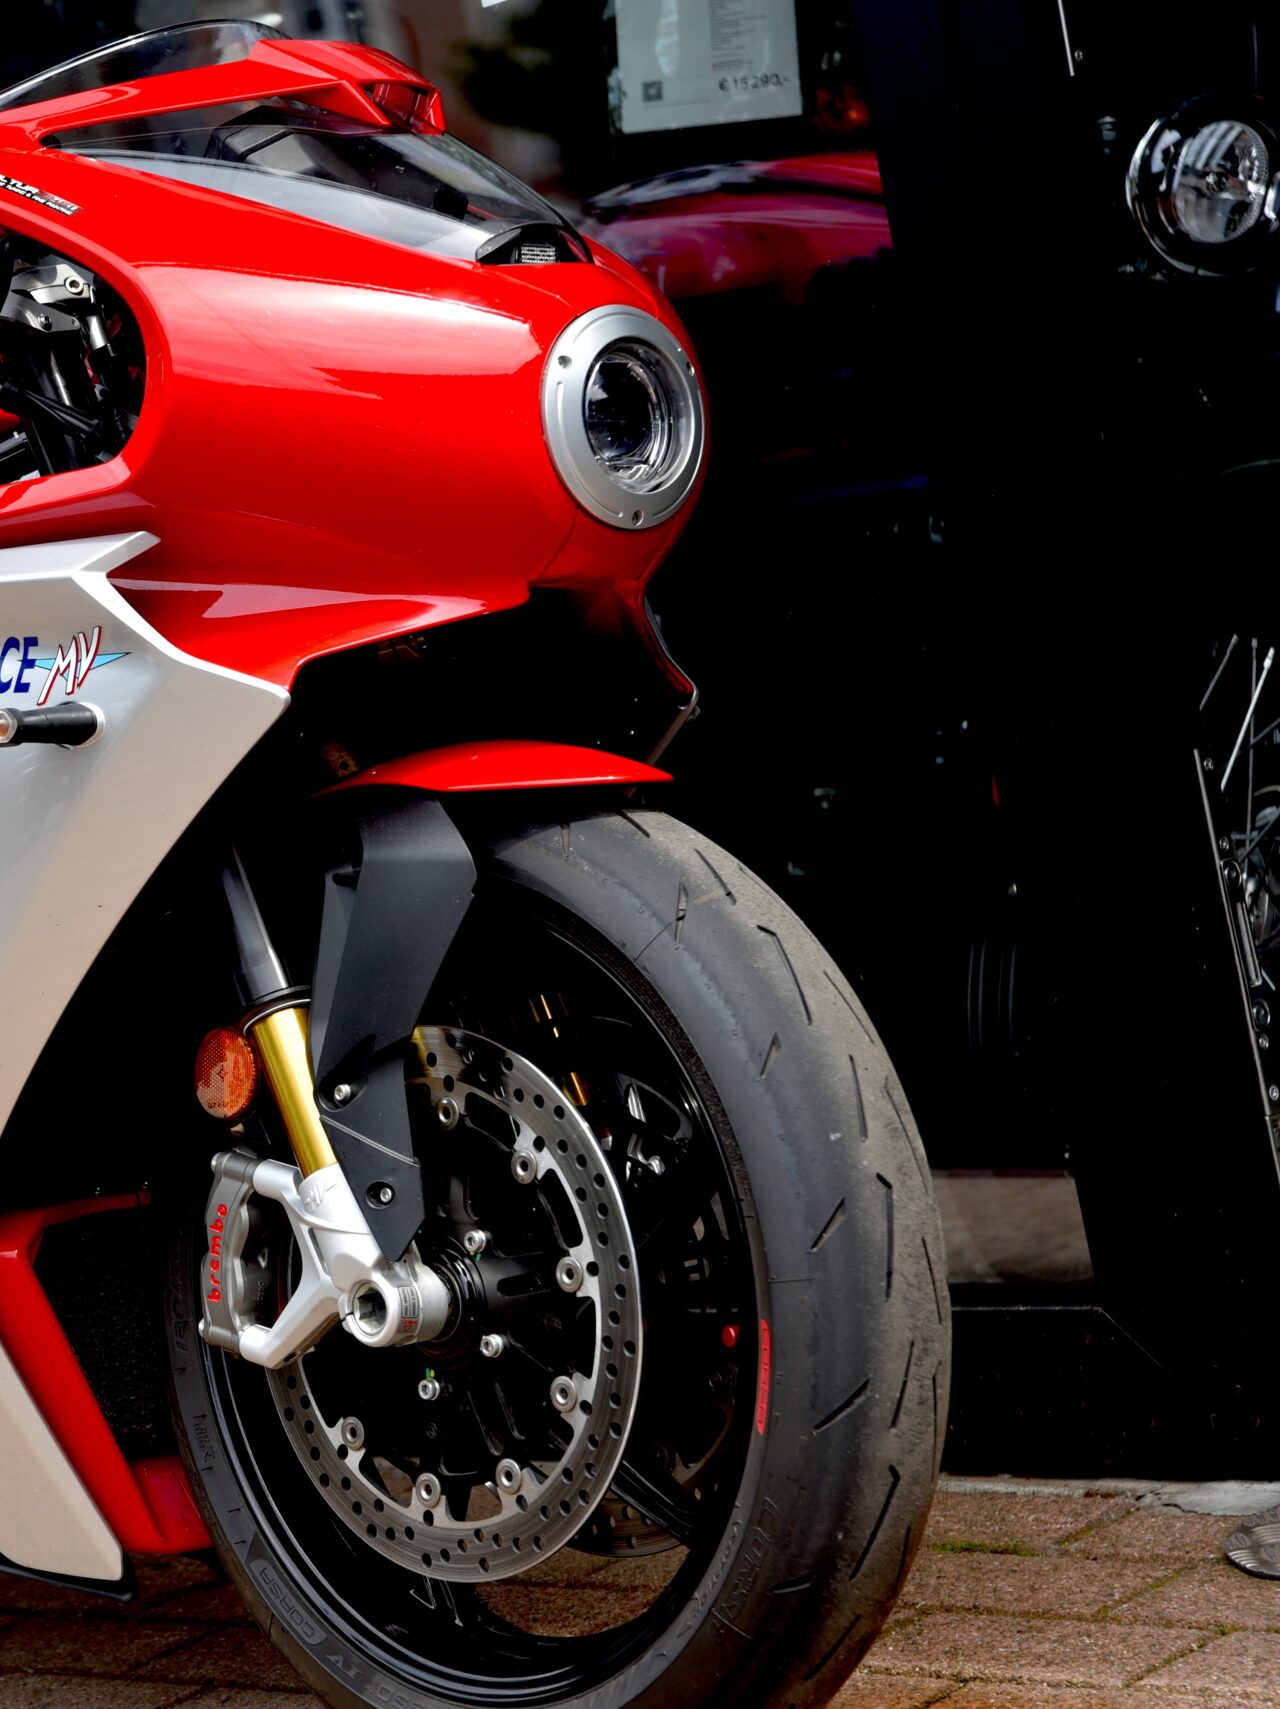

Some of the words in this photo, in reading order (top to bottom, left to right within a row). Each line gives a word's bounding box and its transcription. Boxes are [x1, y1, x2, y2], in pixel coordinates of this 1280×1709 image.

[36, 625, 103, 706] MV
[207, 1203, 228, 1303] brembo
[259, 1567, 316, 1638] CORSA
